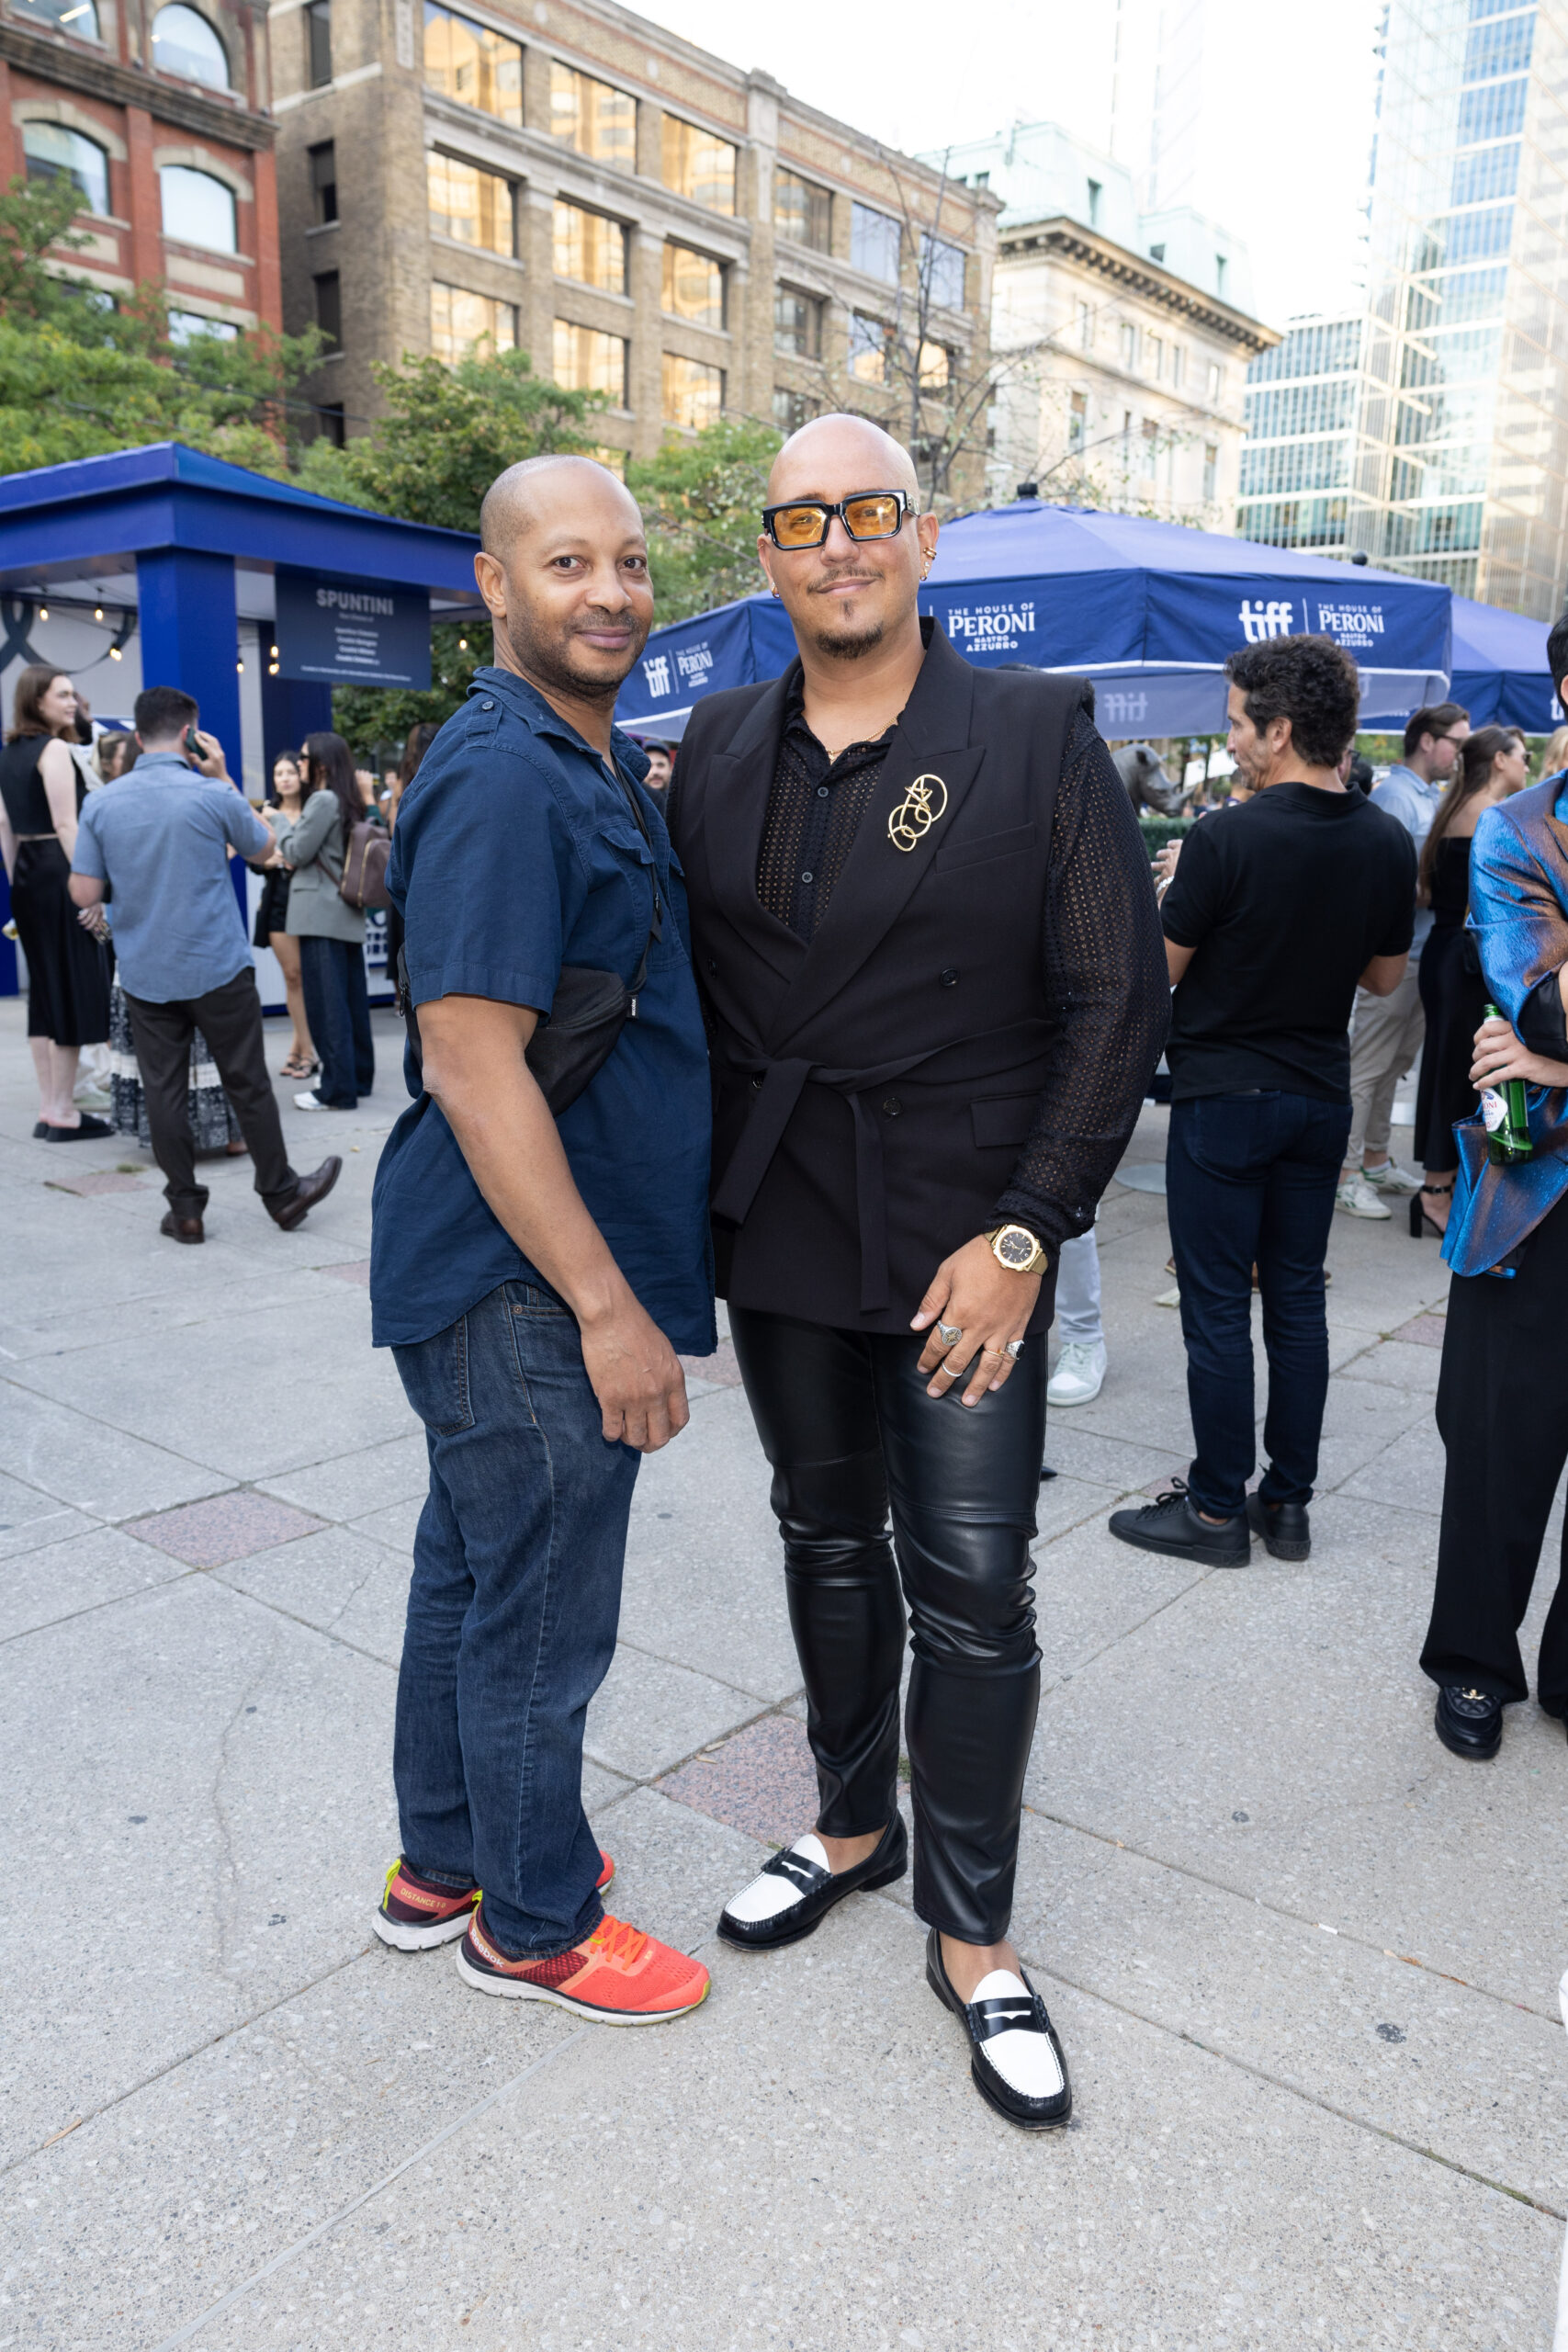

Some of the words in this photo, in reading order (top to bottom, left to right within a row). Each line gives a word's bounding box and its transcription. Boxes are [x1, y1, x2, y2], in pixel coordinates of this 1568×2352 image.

[316, 589, 393, 616] SPUNTINI
[948, 608, 969, 616] THE
[976, 604, 1014, 615] HOUSE
[1021, 602, 1034, 611] OF
[1338, 605, 1368, 614] HOUSE
[948, 611, 1035, 638] PERONI
[1238, 600, 1293, 643] tiff
[1318, 609, 1385, 633] PERONI
[965, 640, 1019, 652] AZZURRO
[974, 635, 1010, 644] NASTRO
[677, 650, 714, 676] PERONI
[642, 655, 671, 698] tiff
[400, 1887, 435, 1908] DISTANCE
[470, 1928, 504, 1968] Reebok
